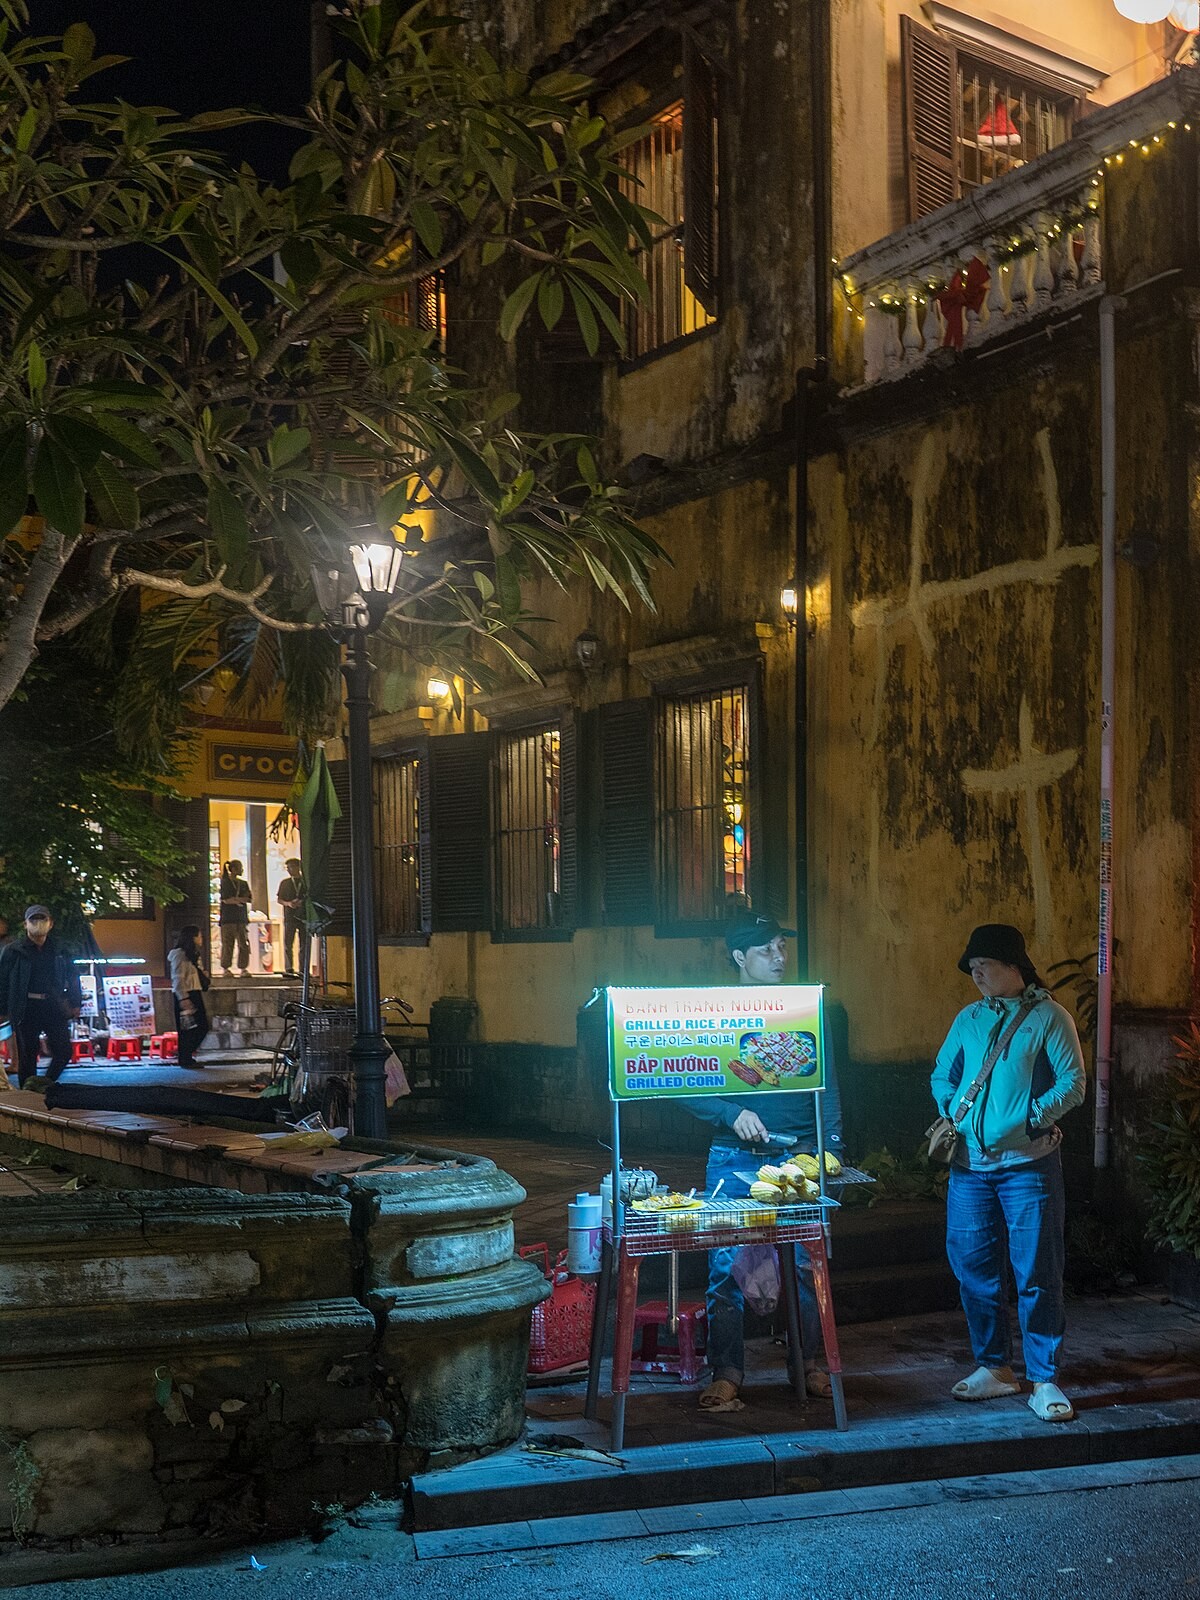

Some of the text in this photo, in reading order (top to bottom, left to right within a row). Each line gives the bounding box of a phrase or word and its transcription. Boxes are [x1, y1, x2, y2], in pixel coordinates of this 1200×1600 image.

[219, 753, 294, 776] croc
[109, 983, 143, 996] CHÈ
[625, 1017, 764, 1031] GRILLED RICE PAPER
[625, 1033, 735, 1047] 구운 라이스 페이퍼
[626, 1054, 719, 1074] BẮP NƯỚNG
[626, 1075, 725, 1089] GRILLED CORN
